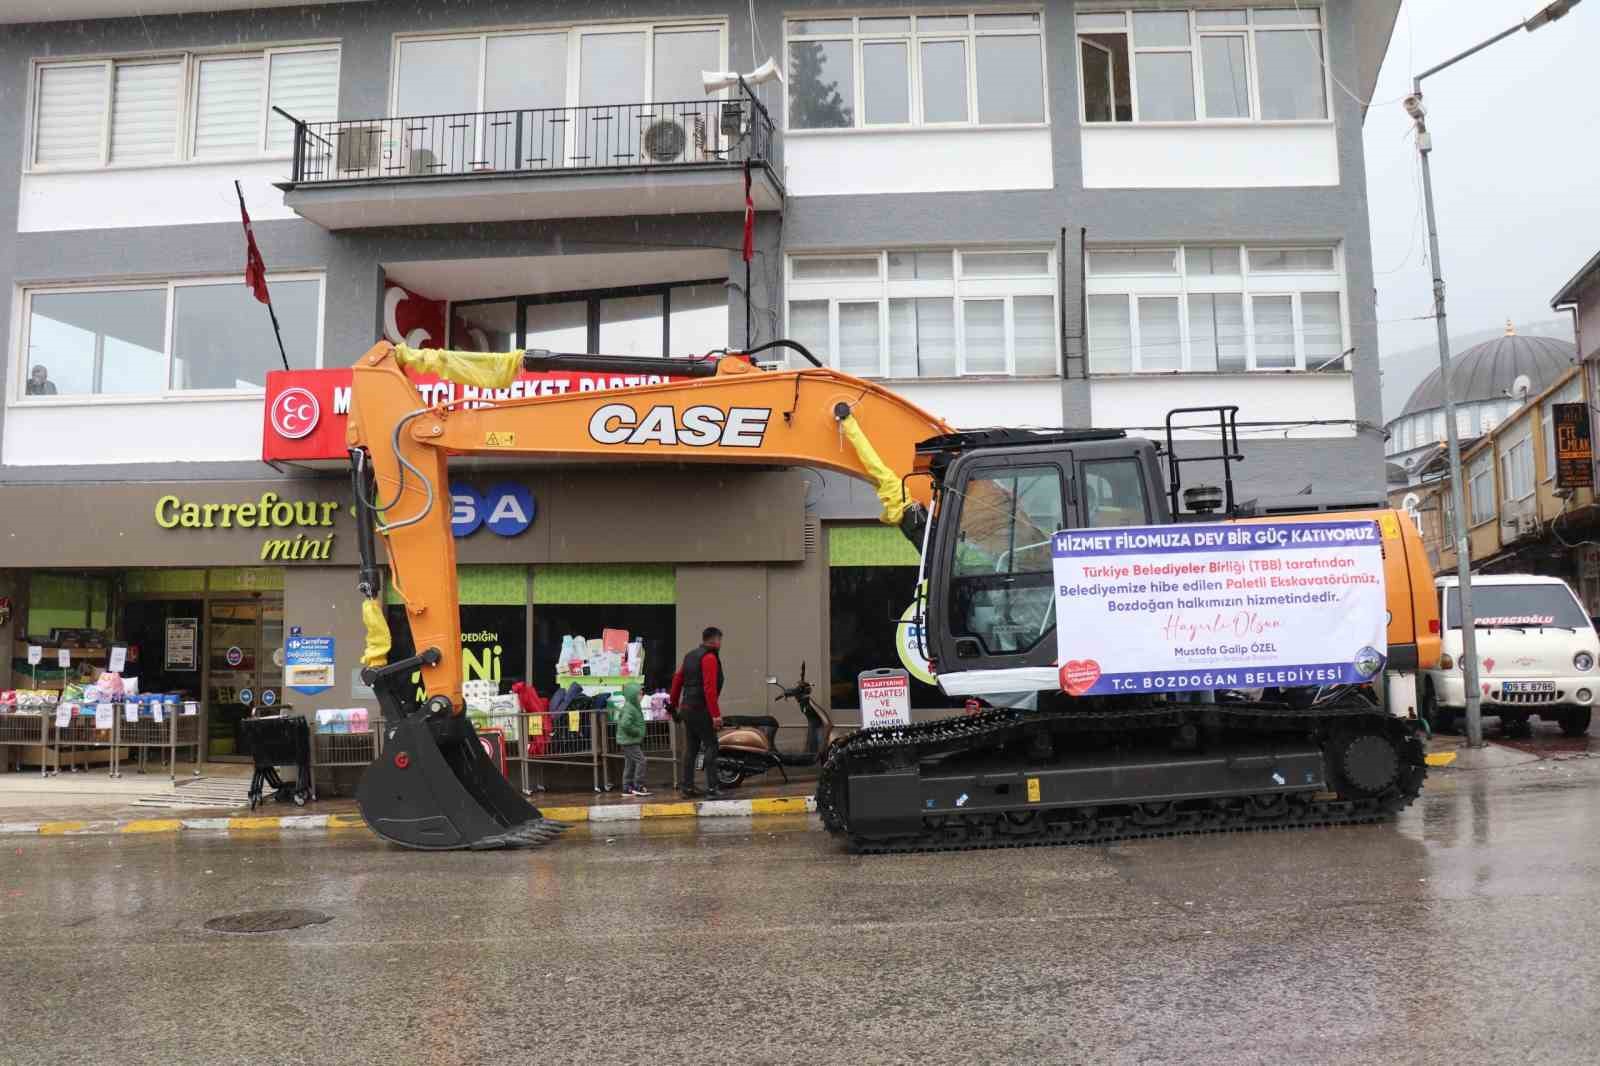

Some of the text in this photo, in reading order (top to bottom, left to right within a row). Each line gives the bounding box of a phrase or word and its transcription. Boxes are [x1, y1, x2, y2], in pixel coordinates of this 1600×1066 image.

[588, 403, 772, 448] CASE
[154, 492, 338, 528] Carrefour
[260, 532, 333, 560] mini
[1057, 527, 1375, 551] HİZMET FİLOMUZA DEV BİR GÜÇ KATIYORUZ
[1082, 557, 1355, 580] Türkiye Belediyeler Birliği (TBB) tarafından
[1060, 582, 1146, 598] Belediyemize
[1150, 581, 1179, 593] hibe
[1182, 579, 1223, 592] edilen
[1226, 577, 1267, 589] Paletli
[1108, 592, 1339, 613] Bozdoğan halkımızın hizmetindedir.
[1174, 641, 1277, 657] Mustafa Galip ÖZEL
[1112, 666, 1342, 690] T.C. BOZDOĞAN BELEDİYESİ
